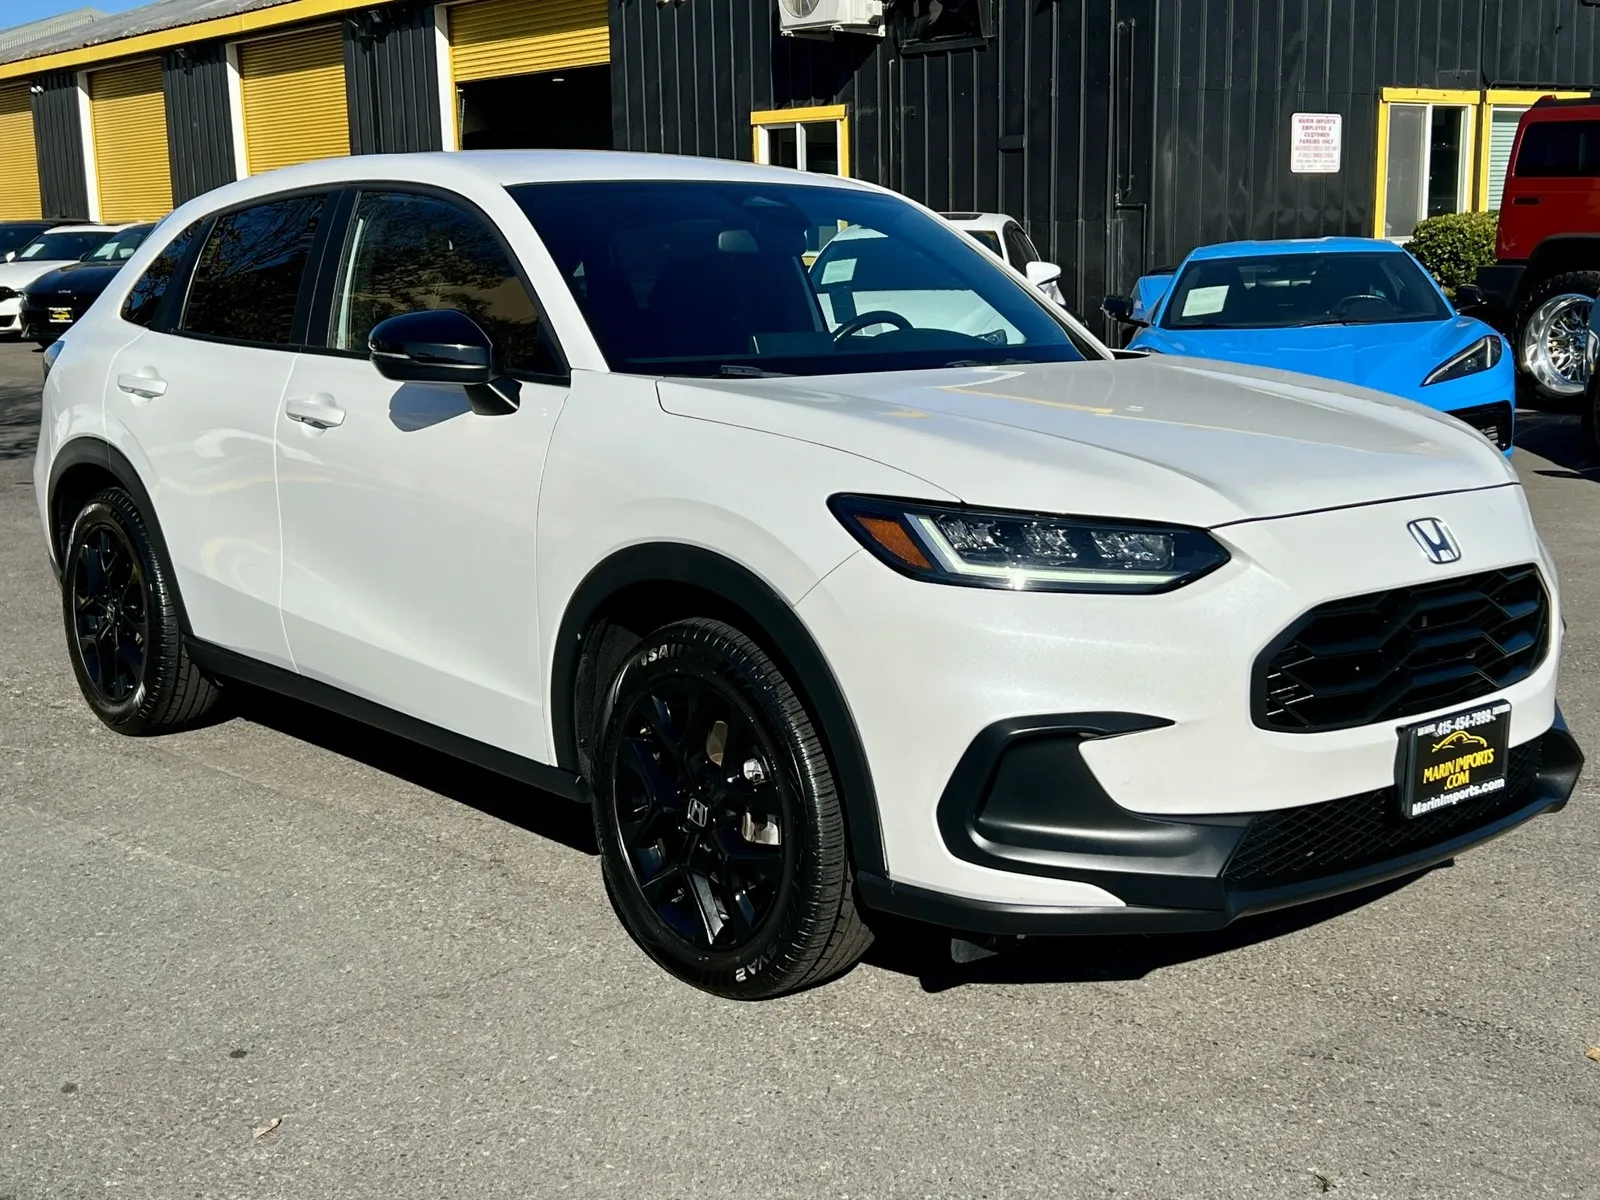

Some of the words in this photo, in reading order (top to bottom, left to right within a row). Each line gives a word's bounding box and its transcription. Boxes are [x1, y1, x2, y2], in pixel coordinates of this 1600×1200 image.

[1423, 760, 1455, 784] MARIN
[1455, 748, 1494, 772] IMPORTS
[1444, 770, 1470, 791] .COM
[1412, 778, 1505, 816] MarinImports.com
